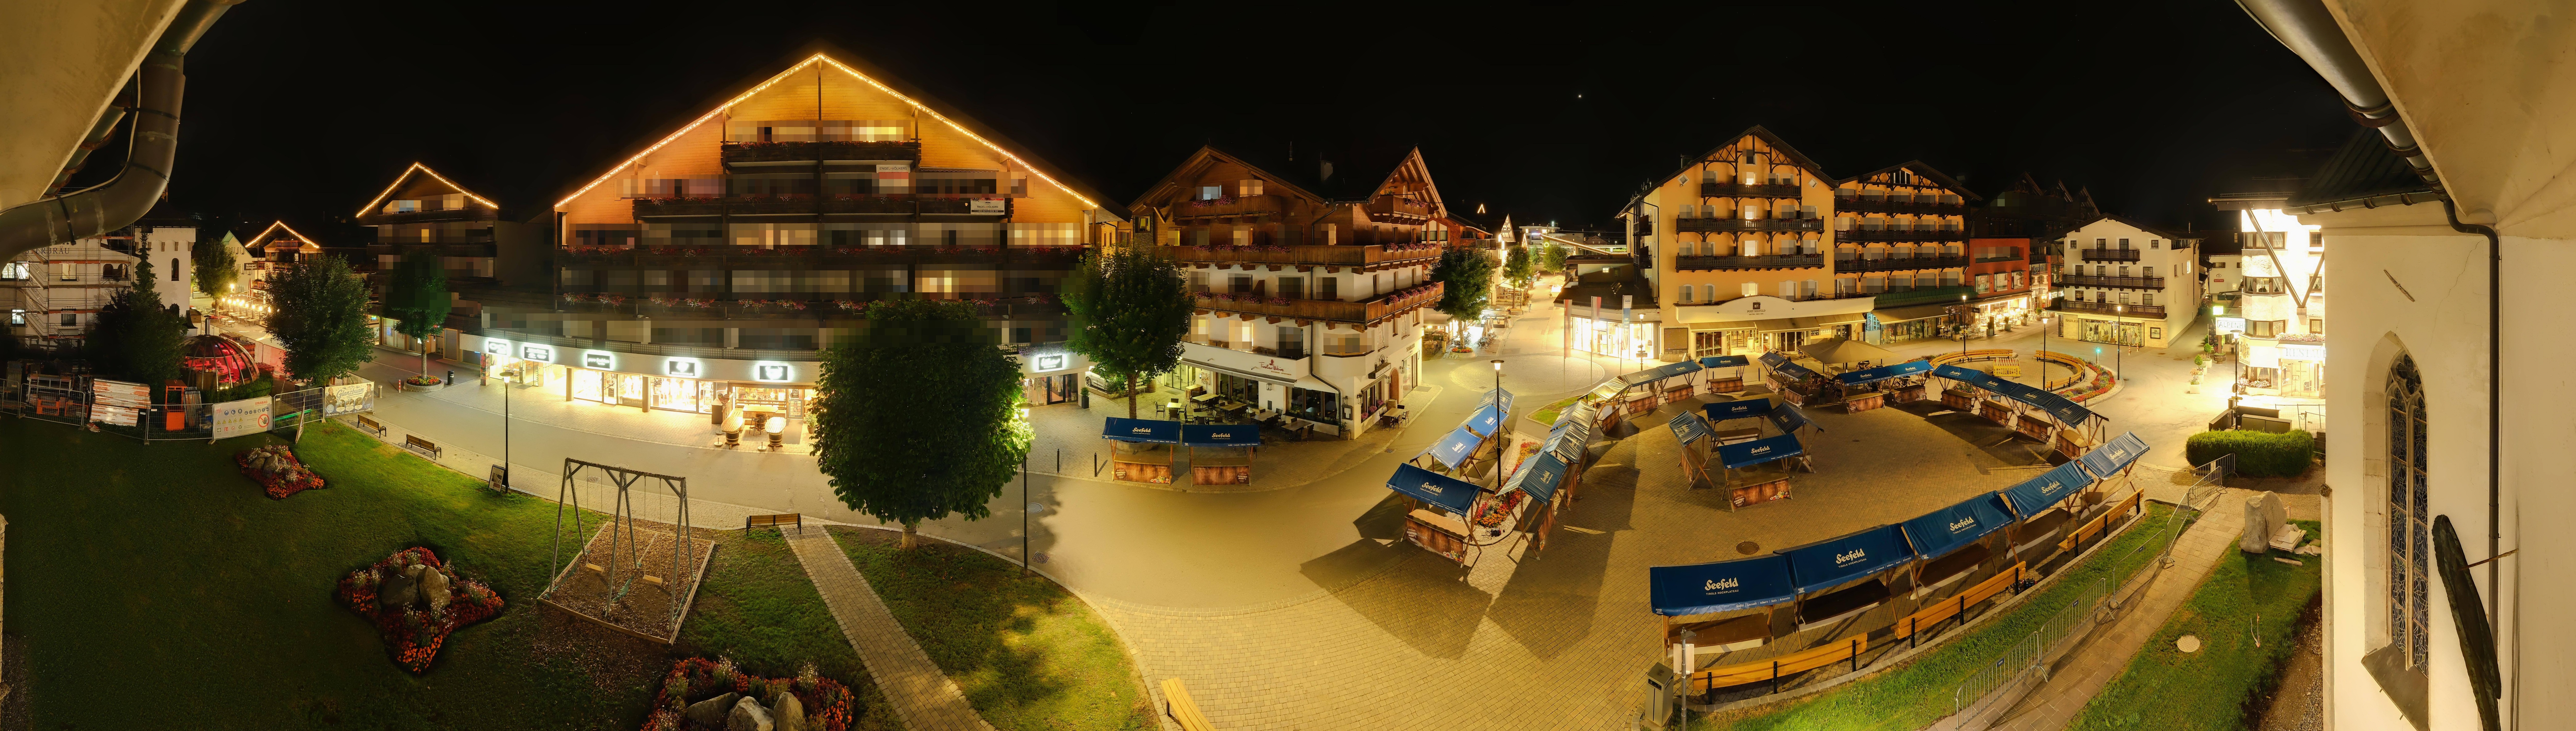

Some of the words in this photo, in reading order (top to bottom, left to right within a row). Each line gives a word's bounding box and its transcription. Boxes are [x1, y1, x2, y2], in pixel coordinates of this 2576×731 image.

[1376, 365, 1391, 377] RESTAURANT
[336, 388, 364, 401] Glanzbuam
[1452, 442, 1463, 452] Seefeld
[1751, 445, 1770, 454] Seefeld
[2109, 449, 2124, 459] Seefeld
[1540, 471, 1550, 483] Seefeld
[1422, 482, 1443, 493] Seefeld
[2041, 481, 2060, 494] Seefeld
[1950, 516, 1974, 531] Seefeld
[1836, 548, 1865, 564] Seefeld
[1705, 577, 1739, 590] Seefeld
